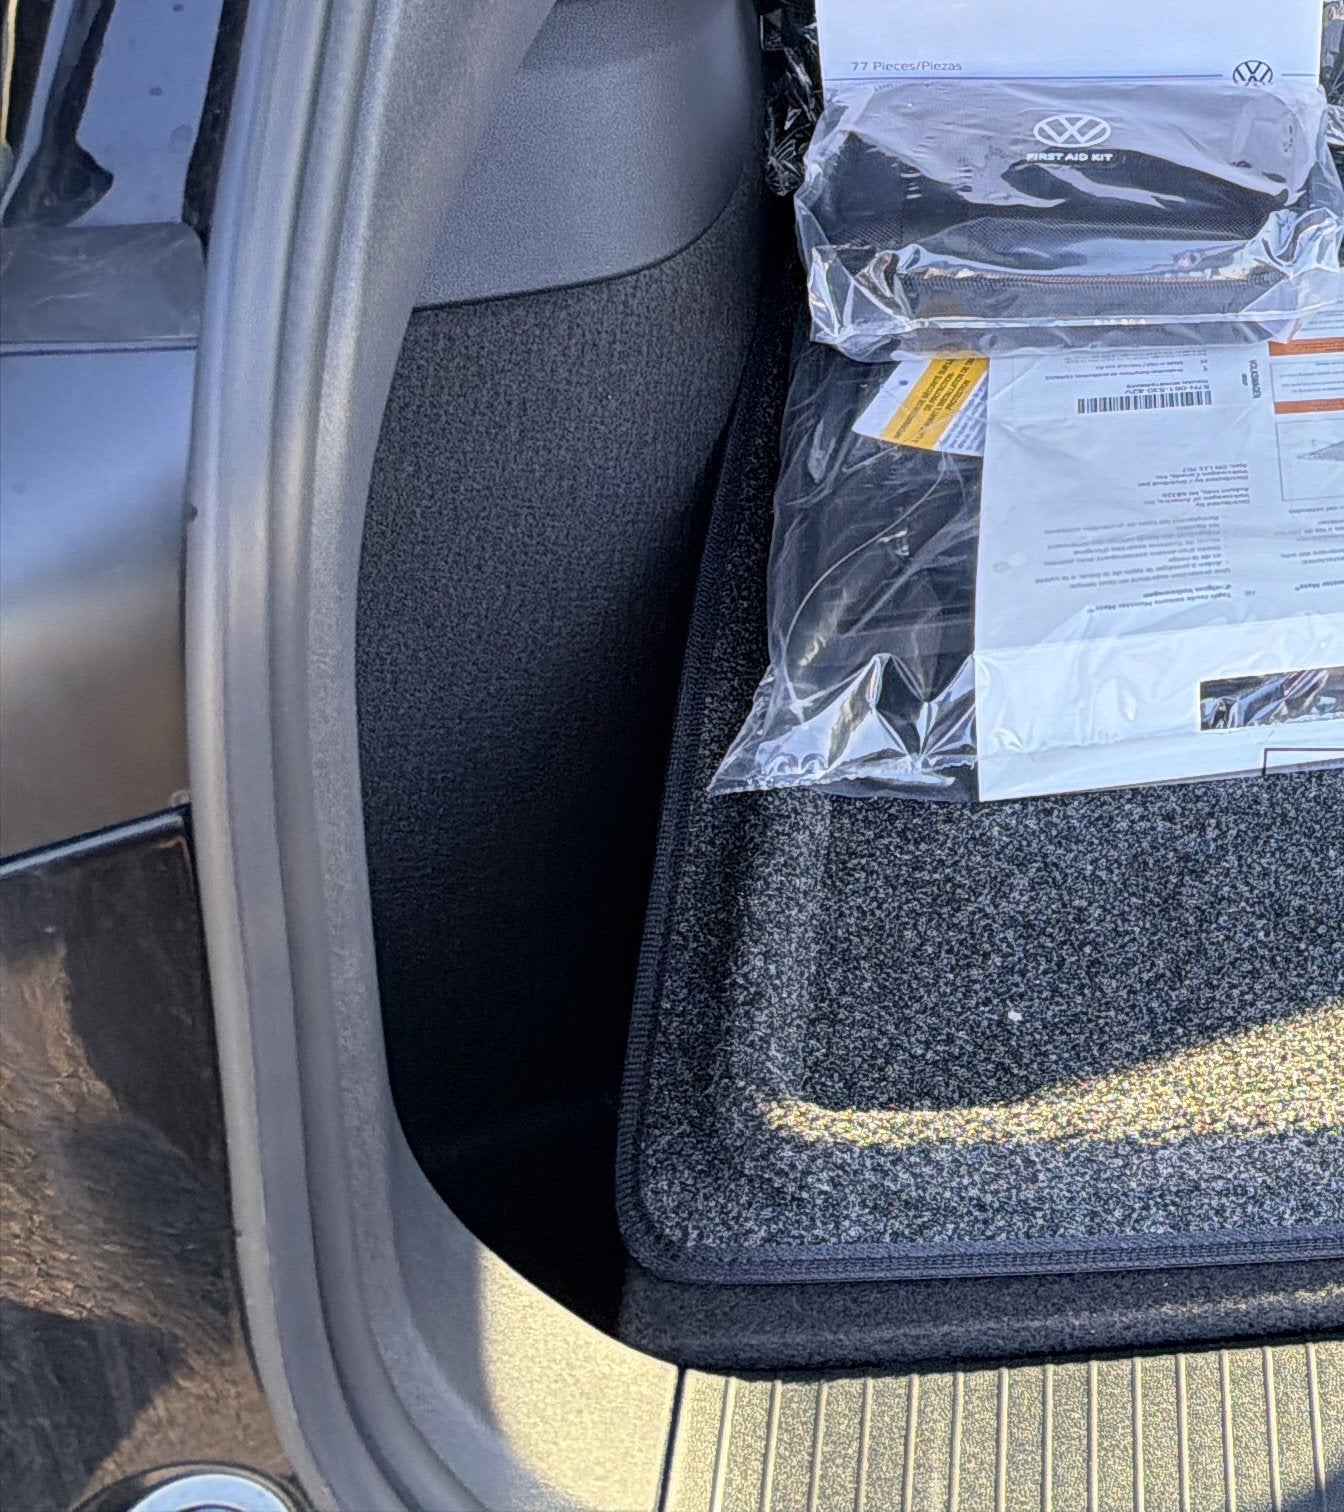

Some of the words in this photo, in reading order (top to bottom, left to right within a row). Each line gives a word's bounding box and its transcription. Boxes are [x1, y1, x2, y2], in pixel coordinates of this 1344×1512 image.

[851, 61, 868, 71] 77
[873, 61, 963, 72] Pieces/Piezas
[1026, 152, 1064, 161] FIRST
[1065, 152, 1089, 161] AID
[1091, 153, 1113, 161] KIT
